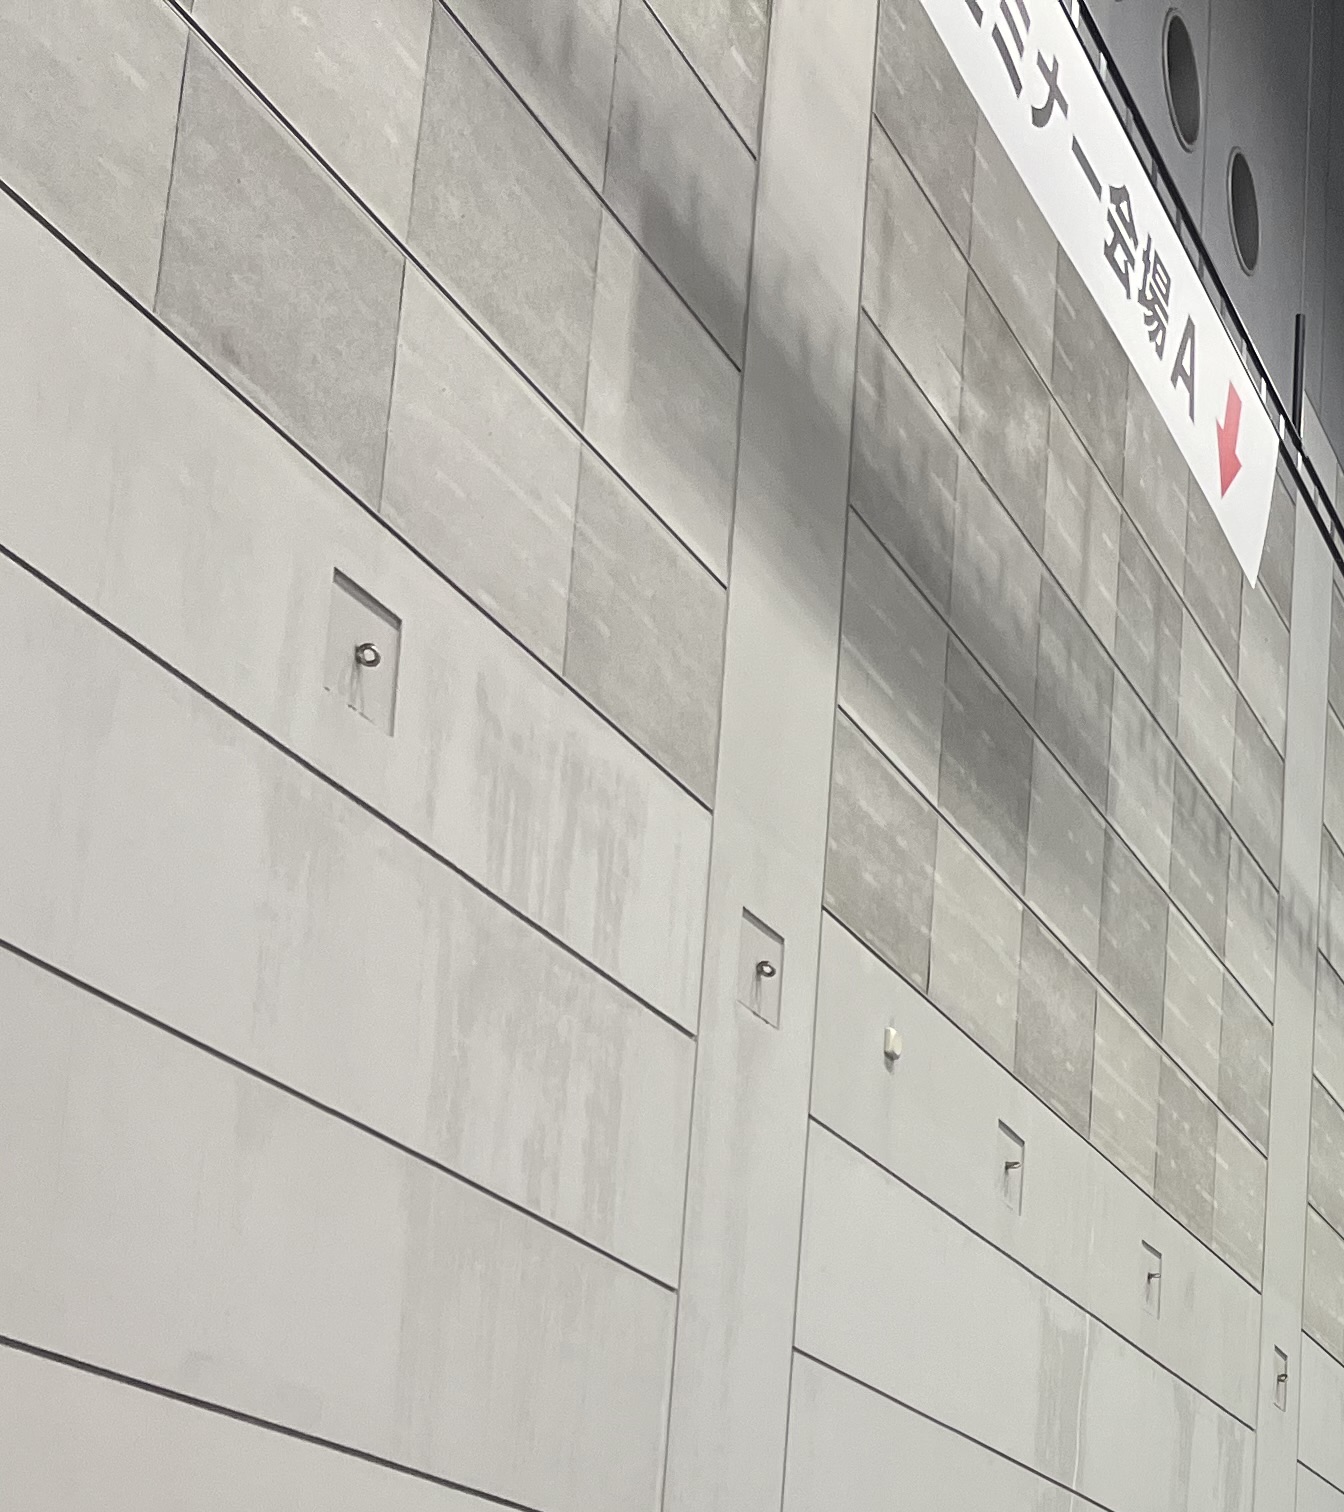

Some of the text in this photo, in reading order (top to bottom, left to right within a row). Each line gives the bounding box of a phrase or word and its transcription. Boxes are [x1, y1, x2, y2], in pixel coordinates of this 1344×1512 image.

[965, 0, 1198, 424] ミナー会場A
